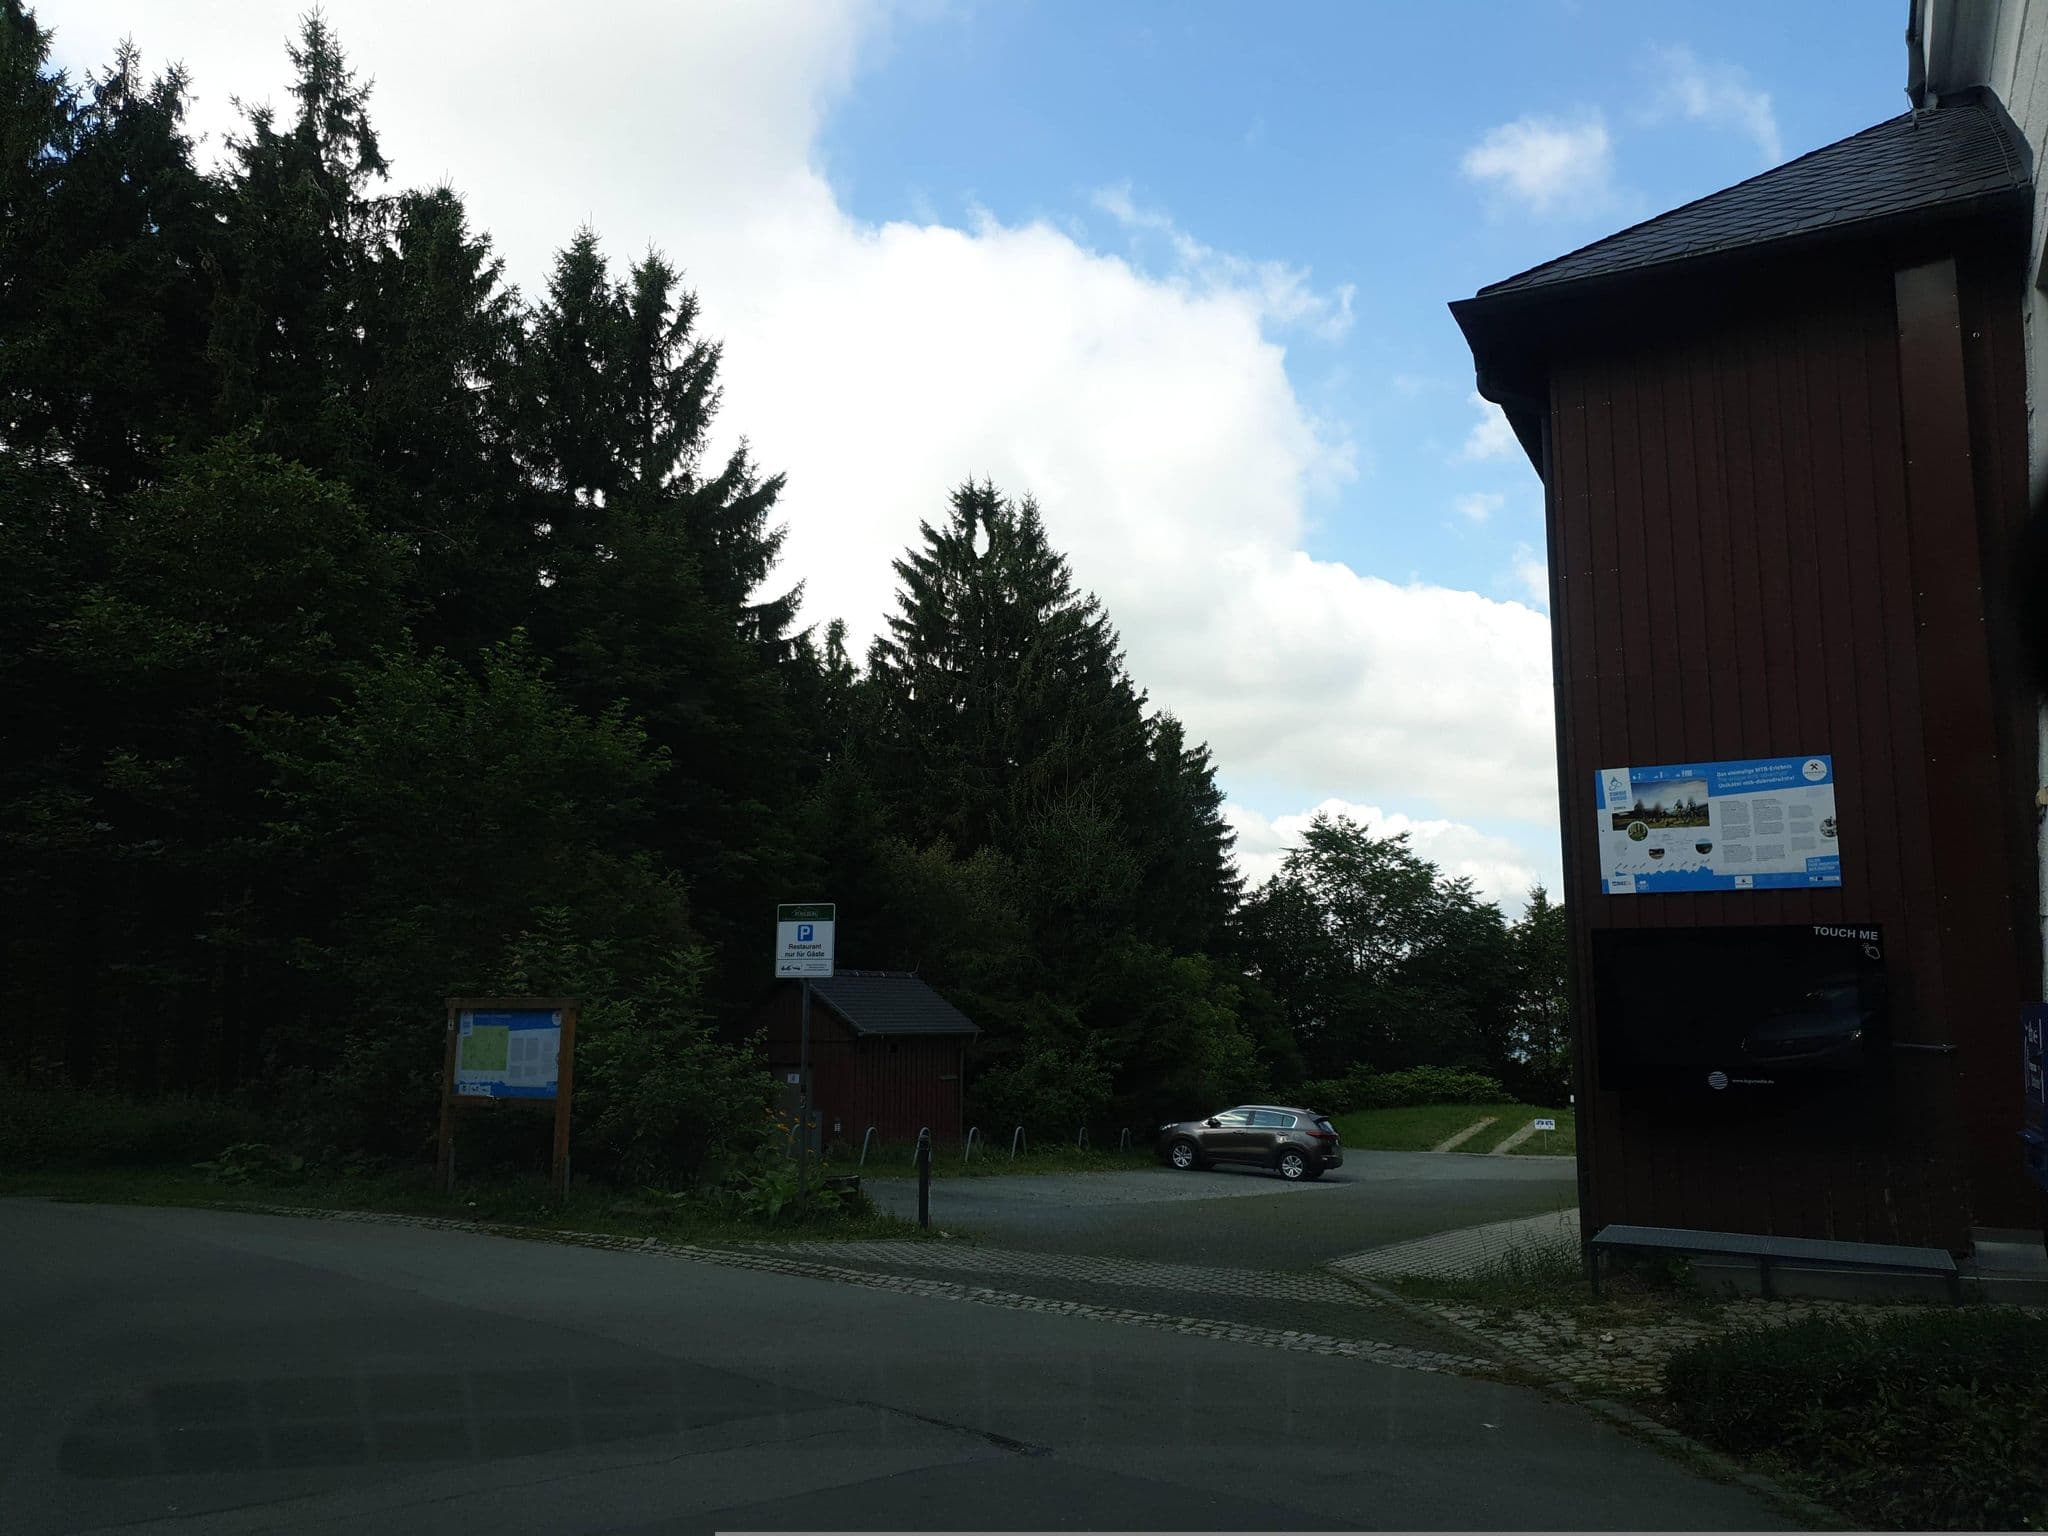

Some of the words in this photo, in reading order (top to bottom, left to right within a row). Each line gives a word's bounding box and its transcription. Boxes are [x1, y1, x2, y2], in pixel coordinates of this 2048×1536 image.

[800, 926, 811, 940] P
[1812, 926, 1856, 939] TOUCH
[1859, 930, 1879, 941] ME
